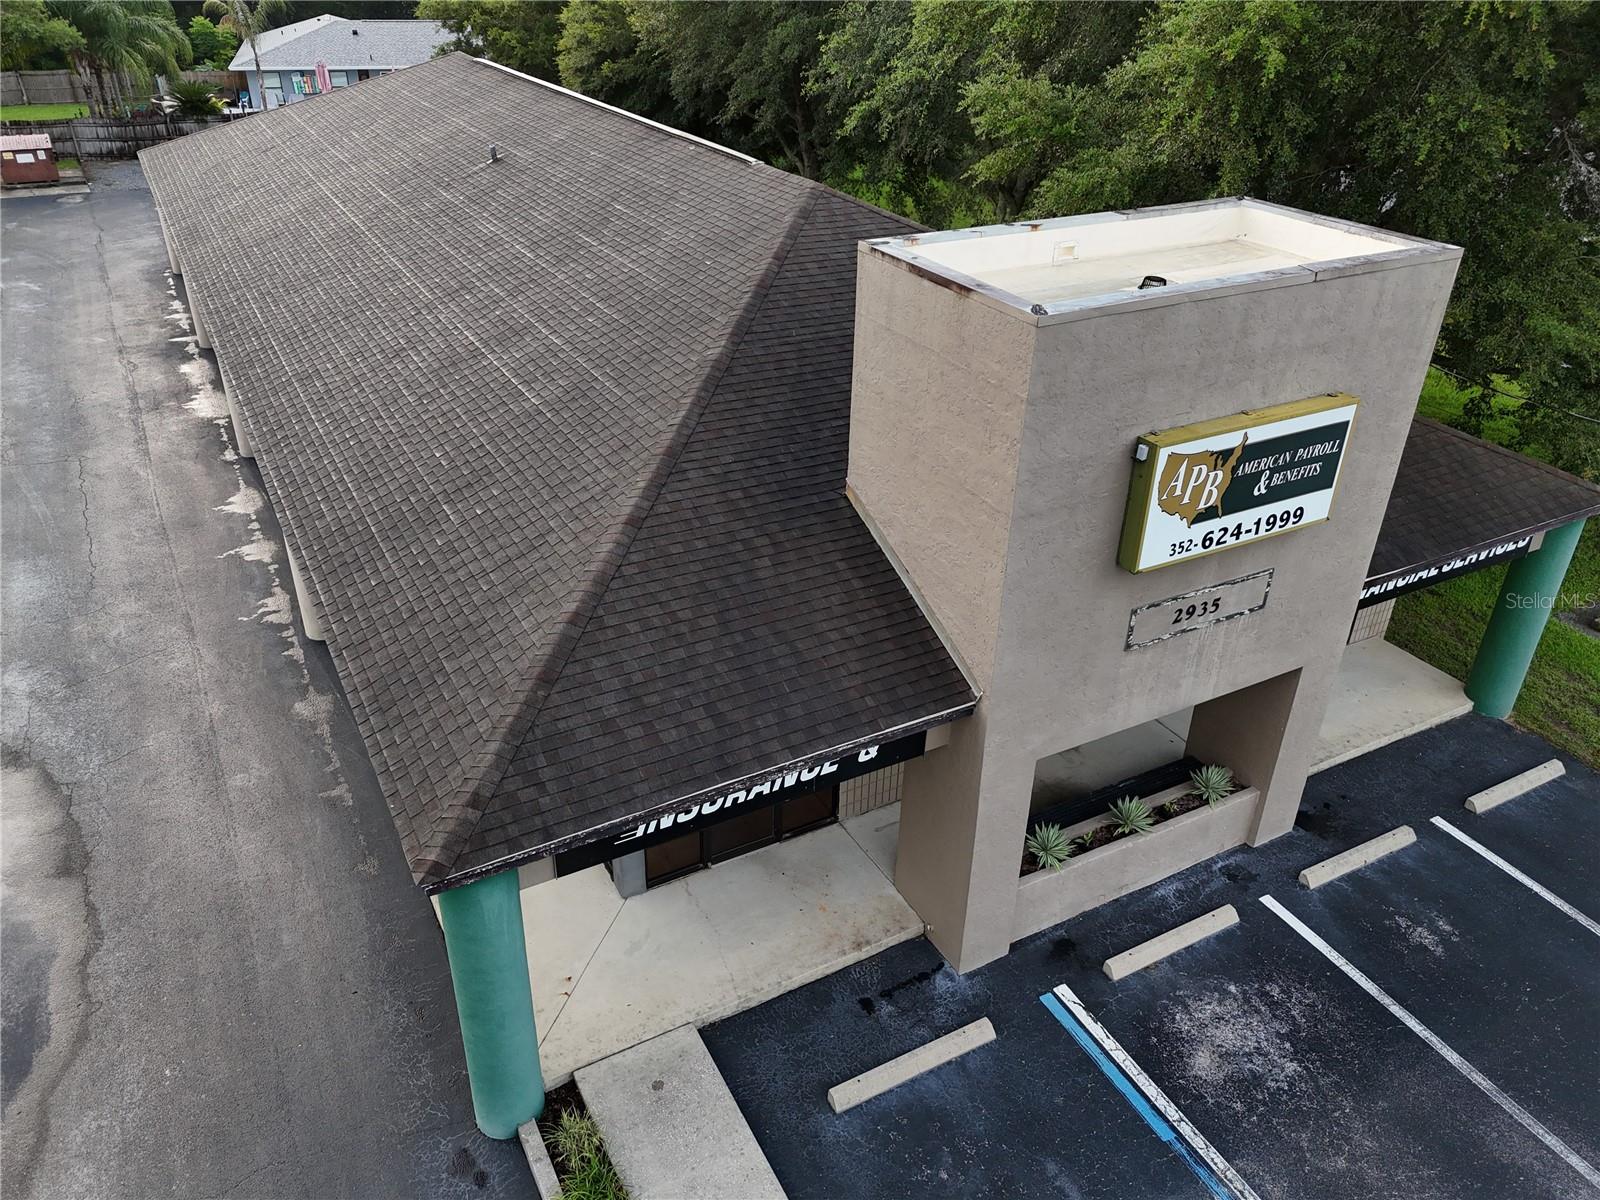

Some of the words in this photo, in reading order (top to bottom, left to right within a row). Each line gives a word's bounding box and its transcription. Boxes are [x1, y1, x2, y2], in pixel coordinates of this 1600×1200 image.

[1234, 450, 1293, 478] AMERICAN
[1294, 439, 1340, 462] PAYROLL
[1161, 457, 1224, 510] APB
[1253, 469, 1271, 496] &
[1270, 461, 1323, 487] BENEFITS
[1172, 597, 1222, 625] 2935
